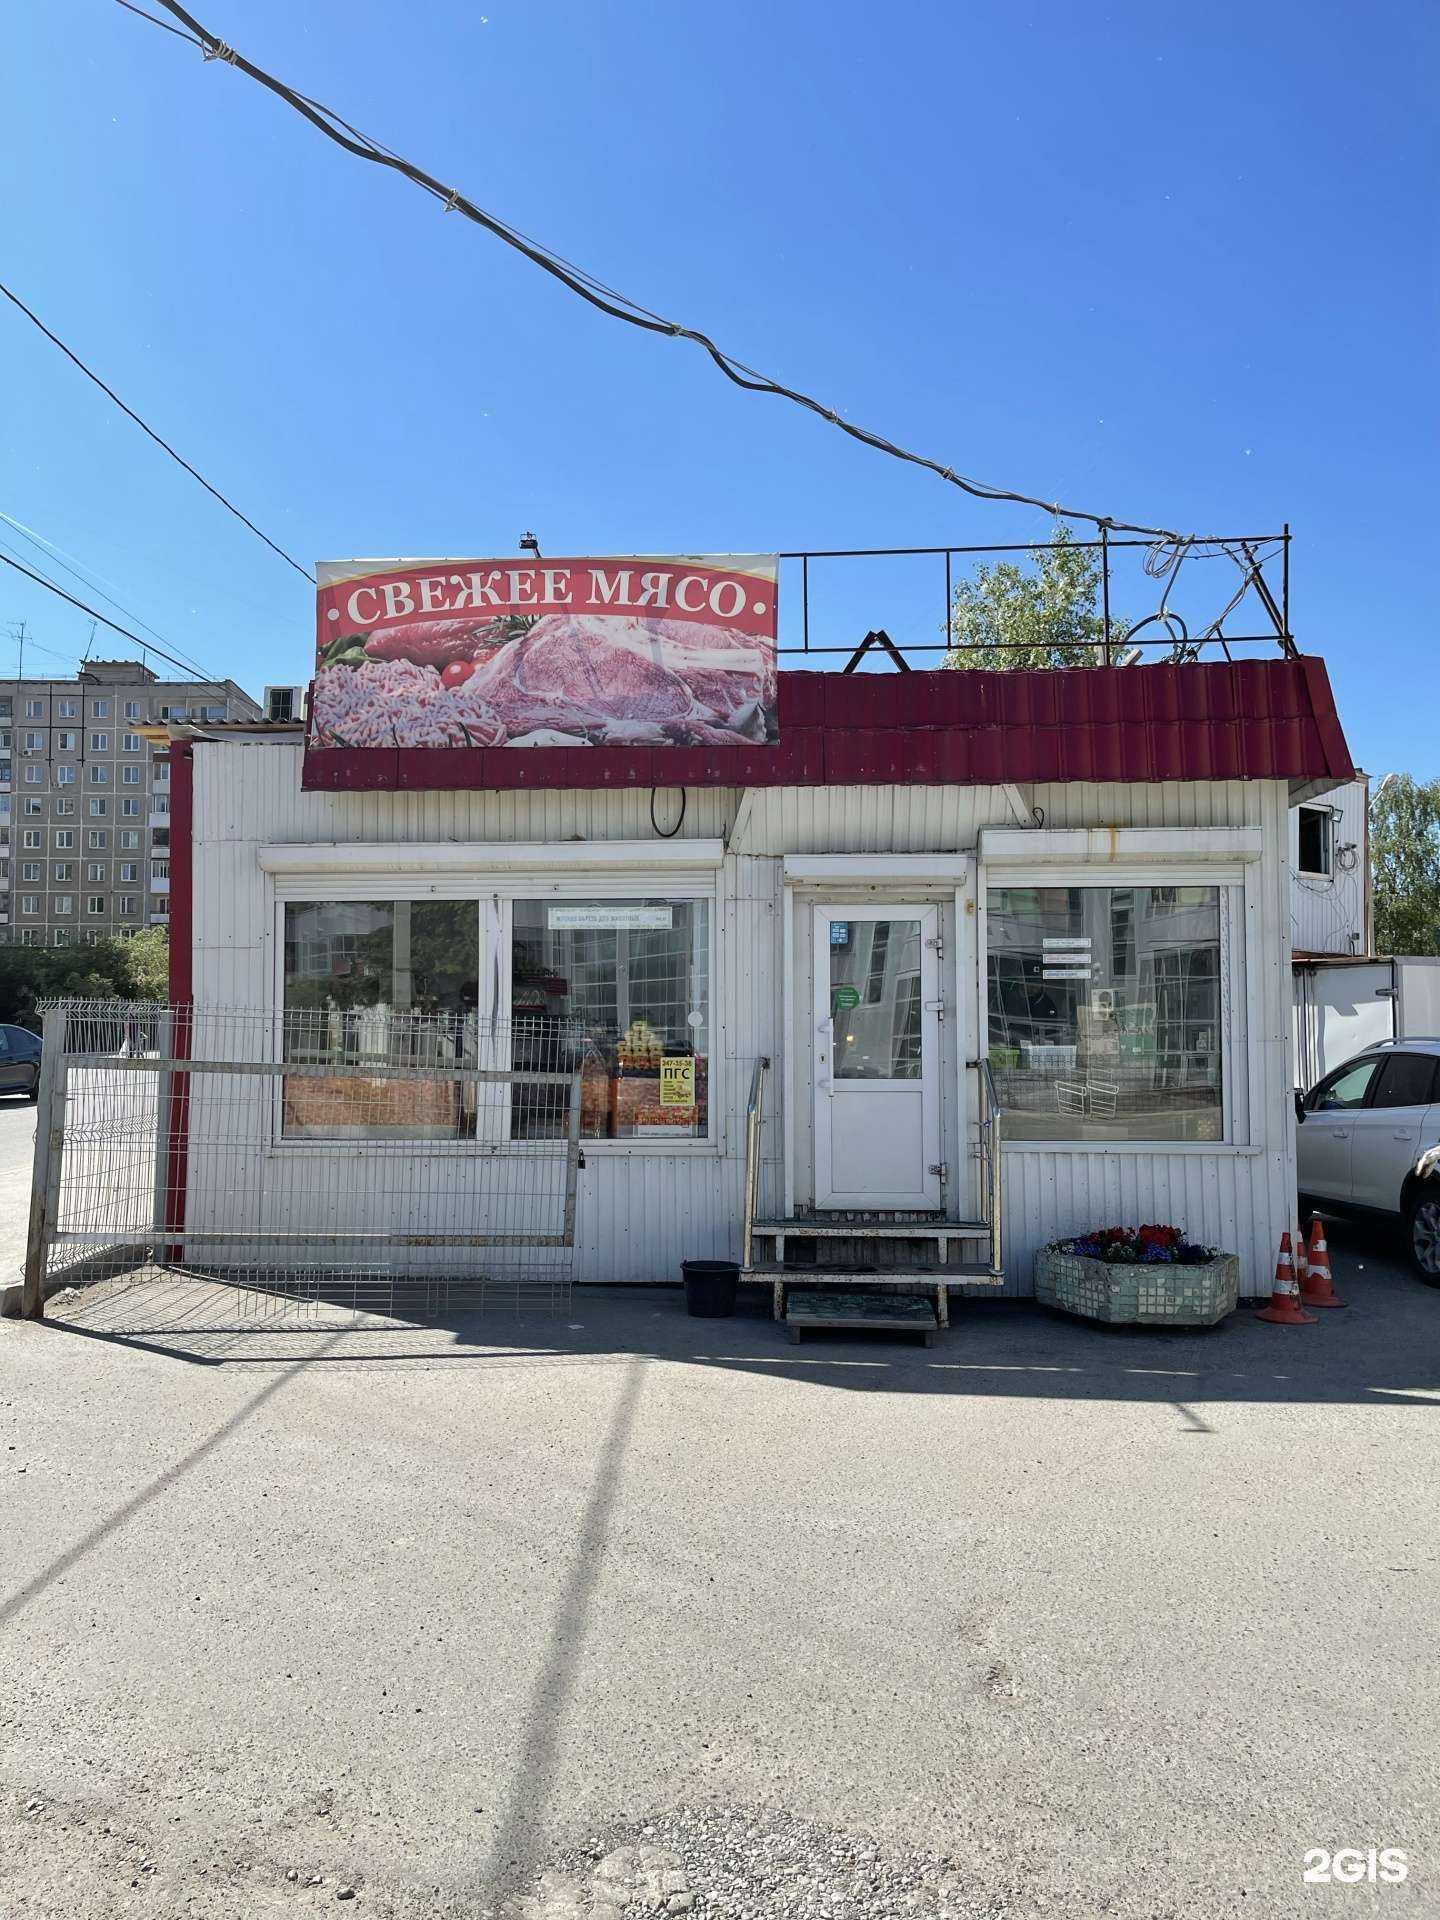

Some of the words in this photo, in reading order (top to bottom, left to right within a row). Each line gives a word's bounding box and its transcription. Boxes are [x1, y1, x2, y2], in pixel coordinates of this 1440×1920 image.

[347, 569, 573, 625] СВЕЖЕЕ
[585, 569, 747, 617] МЯСО
[664, 1068, 690, 1079] ПГС
